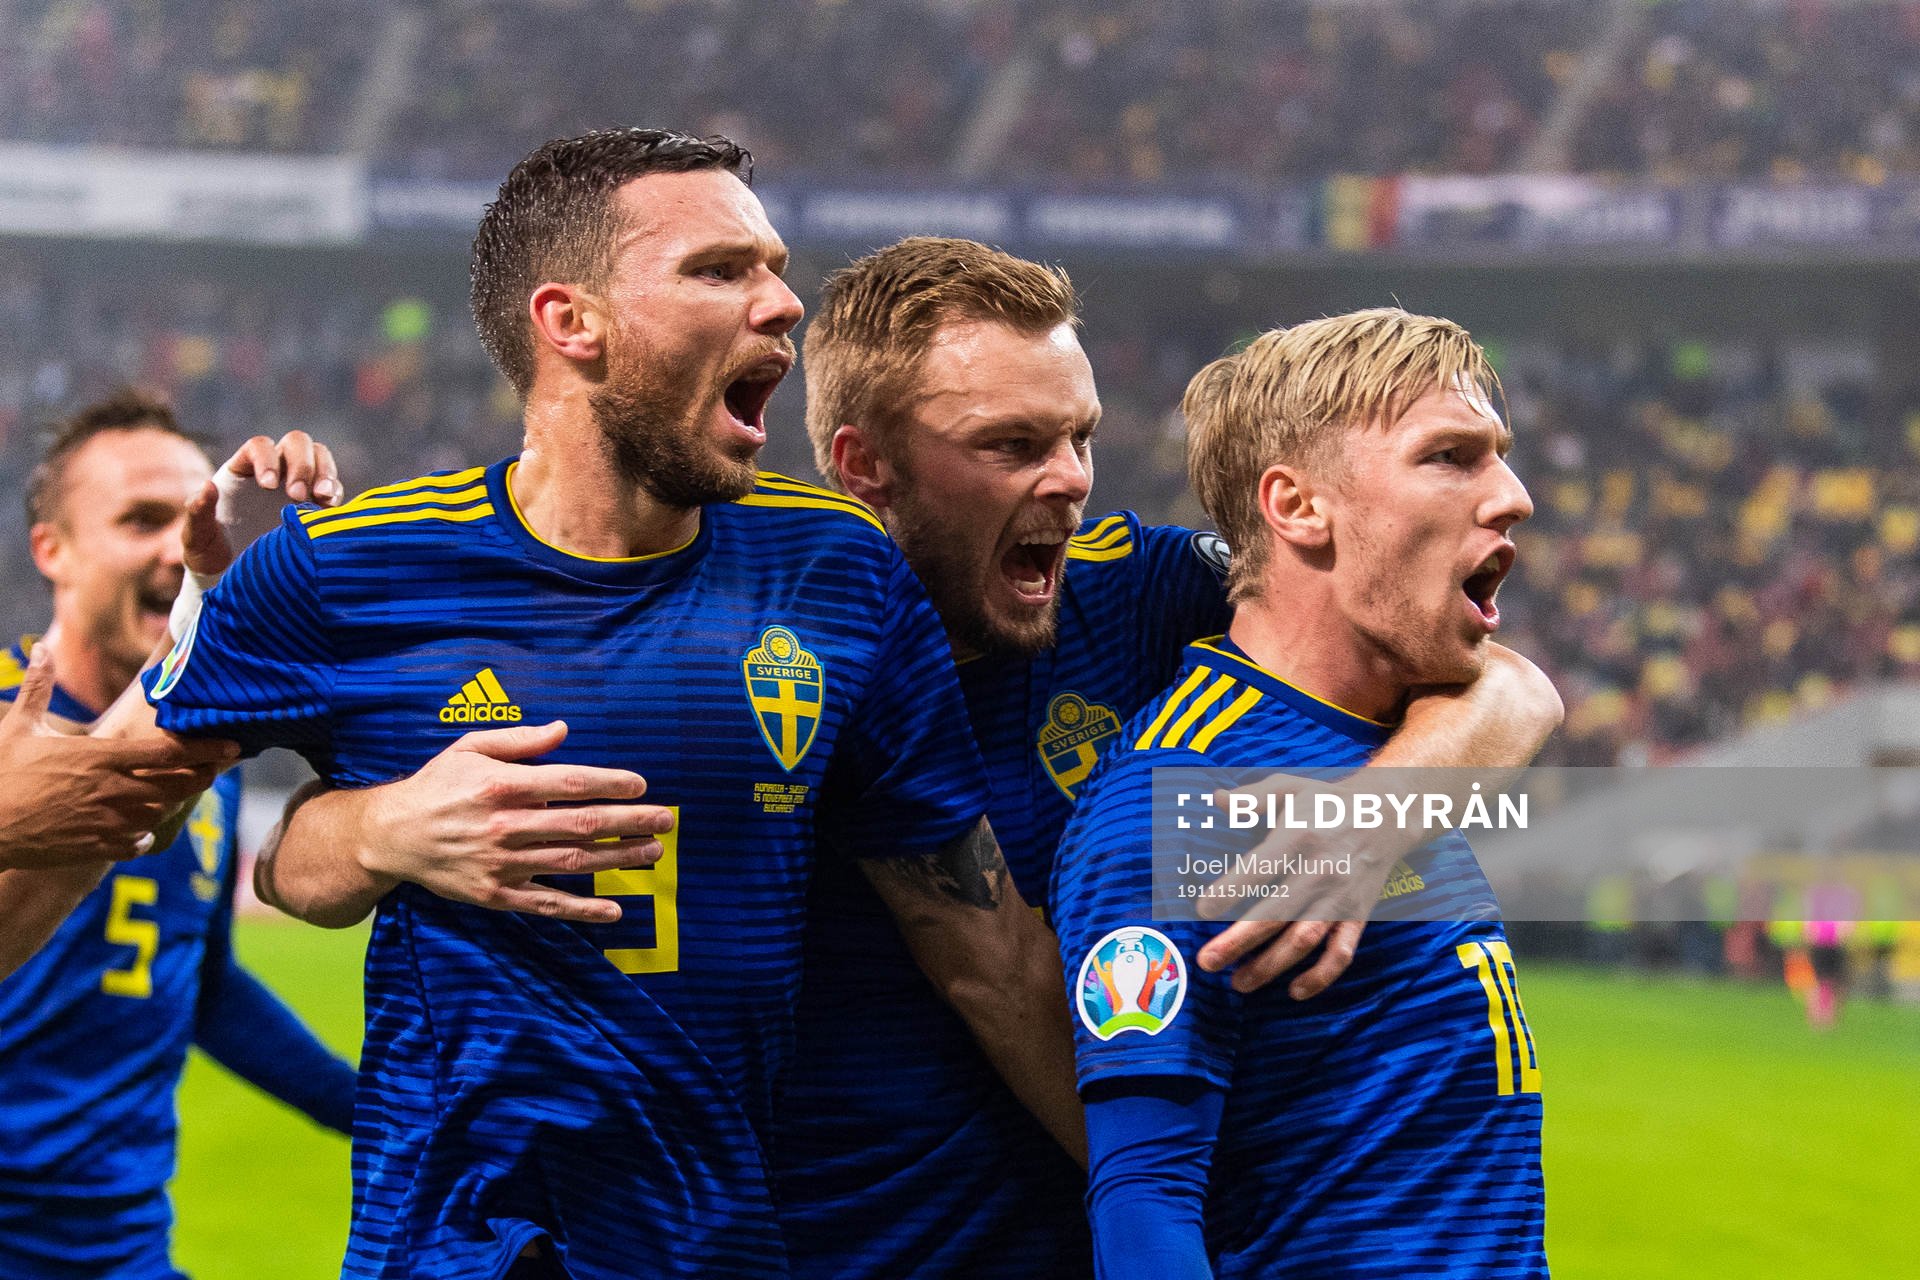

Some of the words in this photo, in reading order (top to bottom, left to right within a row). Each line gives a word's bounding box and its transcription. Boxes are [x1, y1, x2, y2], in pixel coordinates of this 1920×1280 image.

[756, 666, 812, 680] SVERIGE
[439, 702, 523, 723] adidas
[1051, 722, 1107, 752] SVERIGE
[1379, 874, 1425, 899] didas
[103, 875, 158, 998] 5
[1456, 941, 1542, 1096] 10
